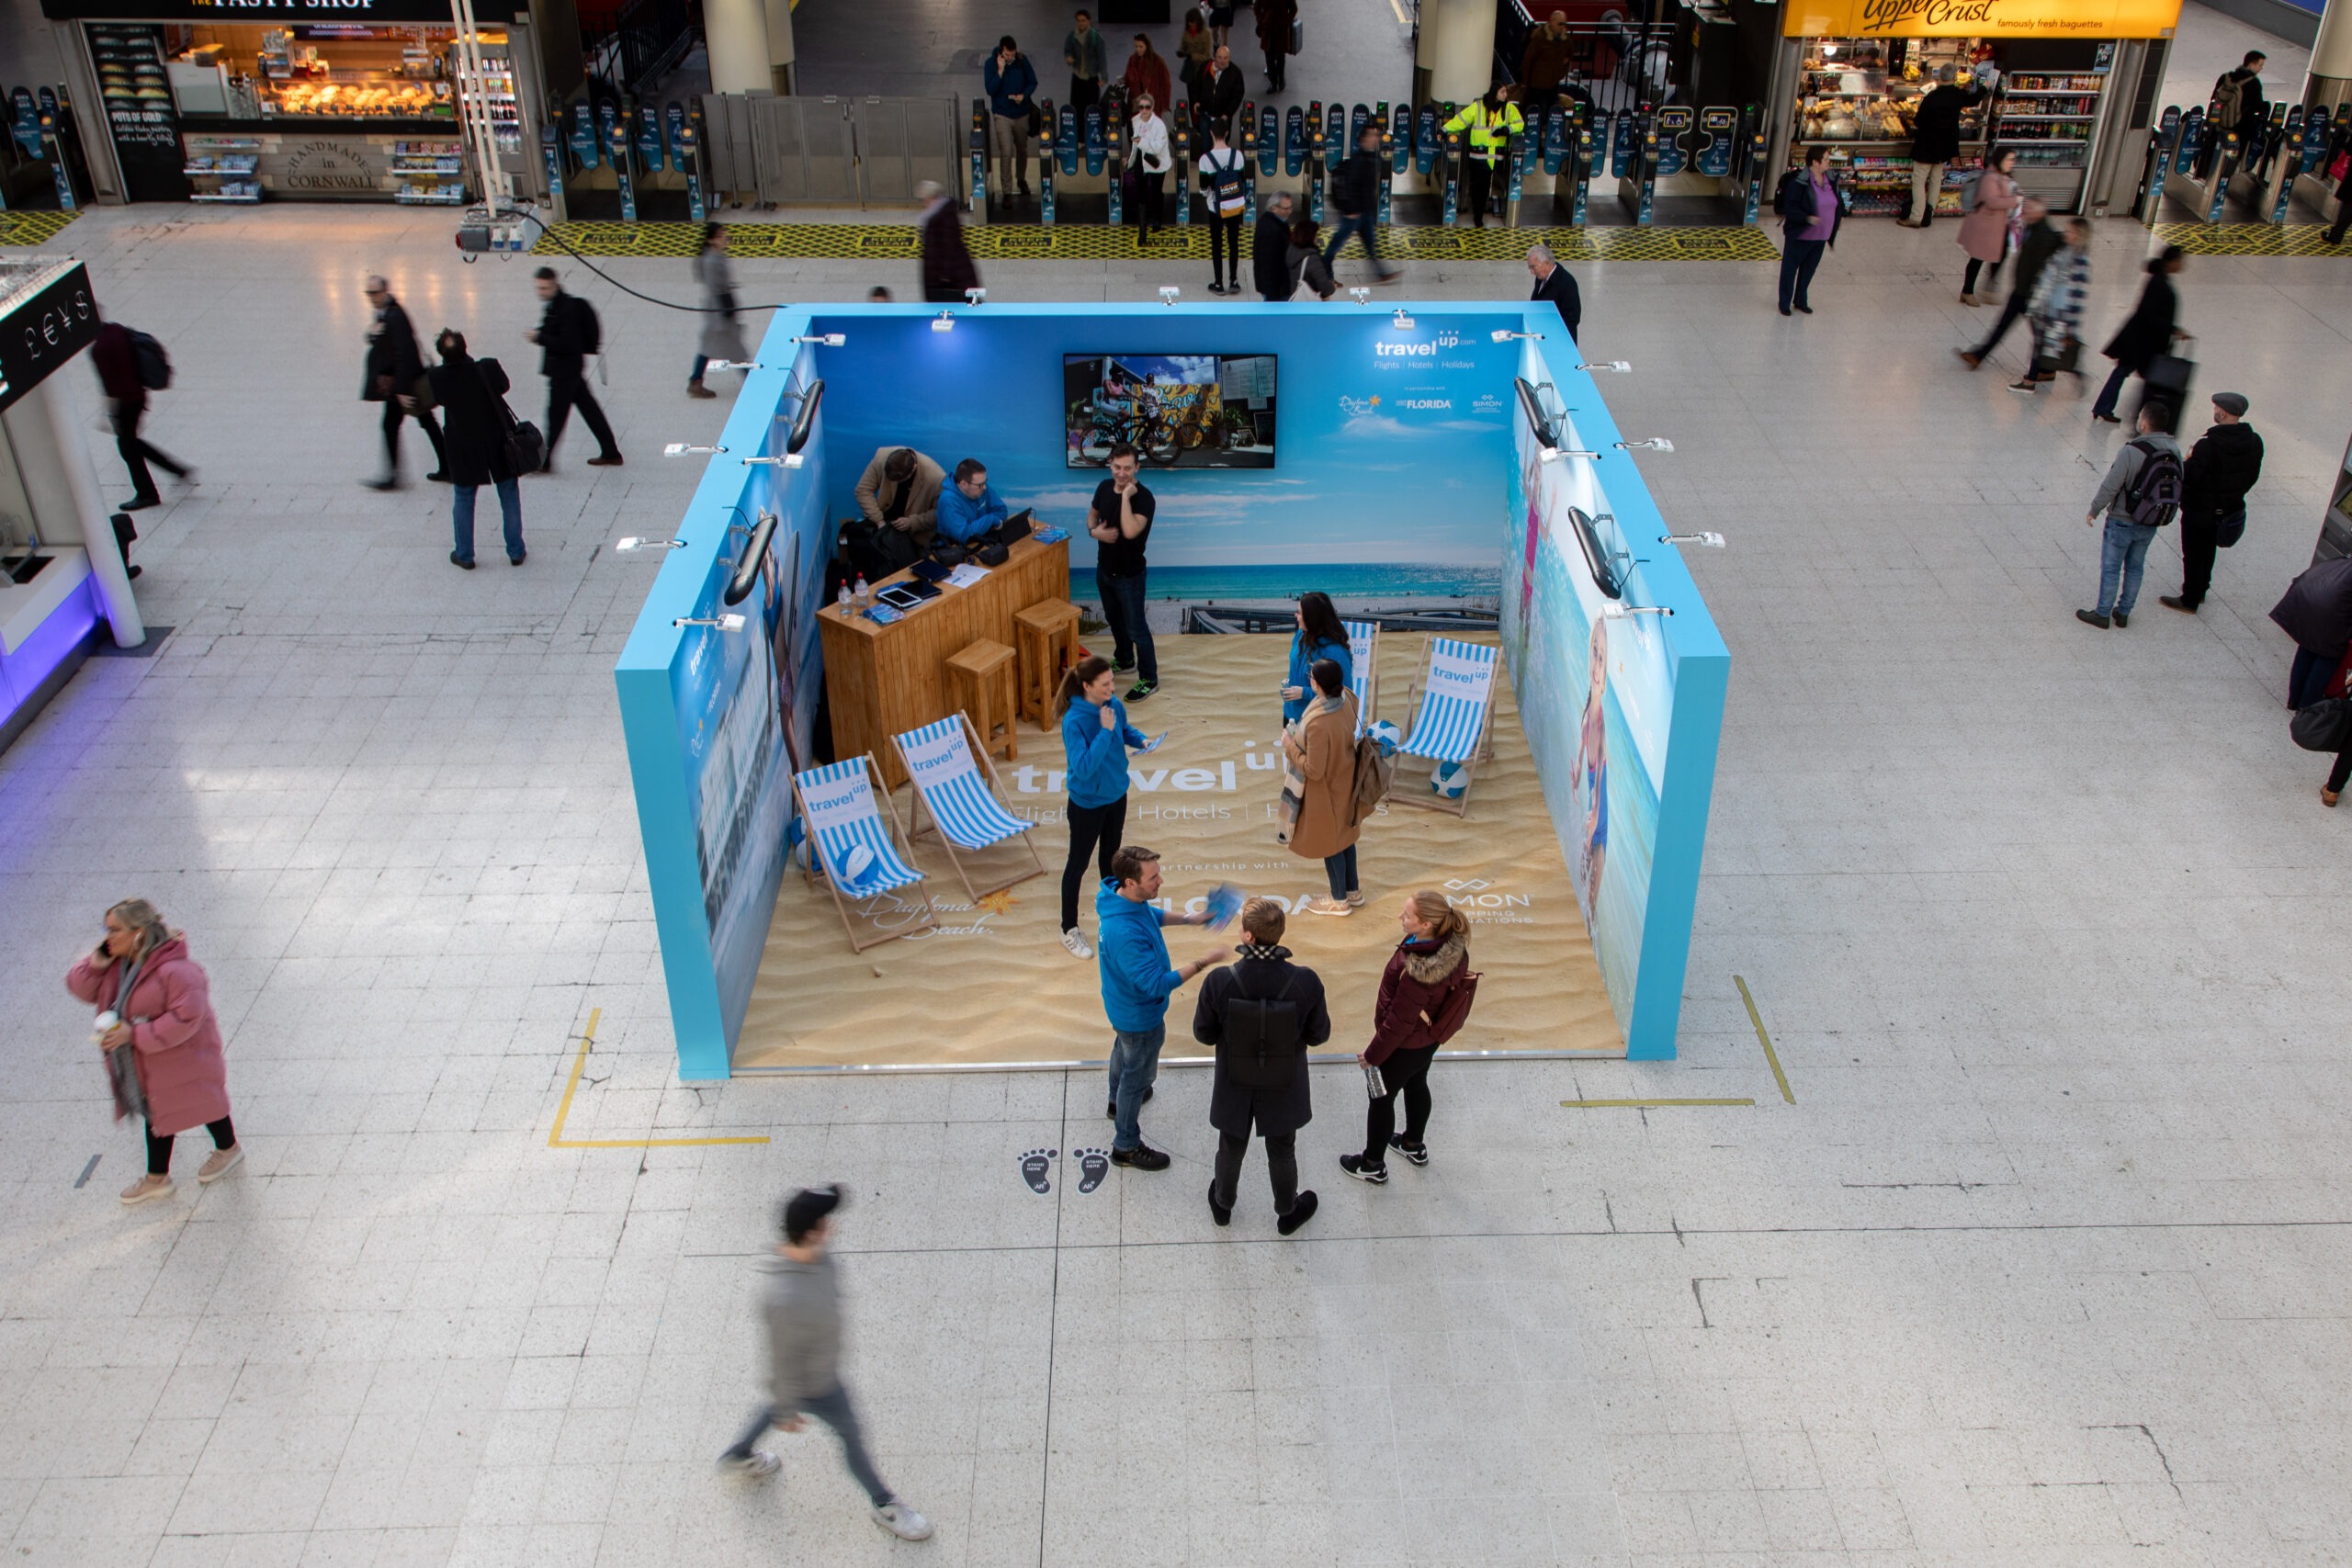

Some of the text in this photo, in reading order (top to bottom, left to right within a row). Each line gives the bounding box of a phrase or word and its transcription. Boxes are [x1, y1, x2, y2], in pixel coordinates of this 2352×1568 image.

[1927, 0, 1998, 26] Crust
[1996, 18, 2103, 30] famously fresh baguettes
[112, 111, 163, 122] POTS OF GOLD
[288, 141, 369, 170] HANDMADE
[322, 157, 336, 169] in
[287, 175, 378, 189] CORNWALL
[1374, 340, 1437, 356] travel
[1374, 360, 1476, 370] Flights Hotels Holidays
[1407, 399, 1453, 410] FLORIDA
[1353, 645, 1367, 657] up
[1433, 665, 1489, 684] travel up
[912, 749, 954, 773] travel
[949, 737, 964, 750] up
[1012, 761, 1237, 794] trvel
[808, 780, 867, 812] travel up
[1138, 805, 1231, 821] Hotels
[1159, 861, 1289, 872] artnership with
[1445, 894, 1530, 908] MON
